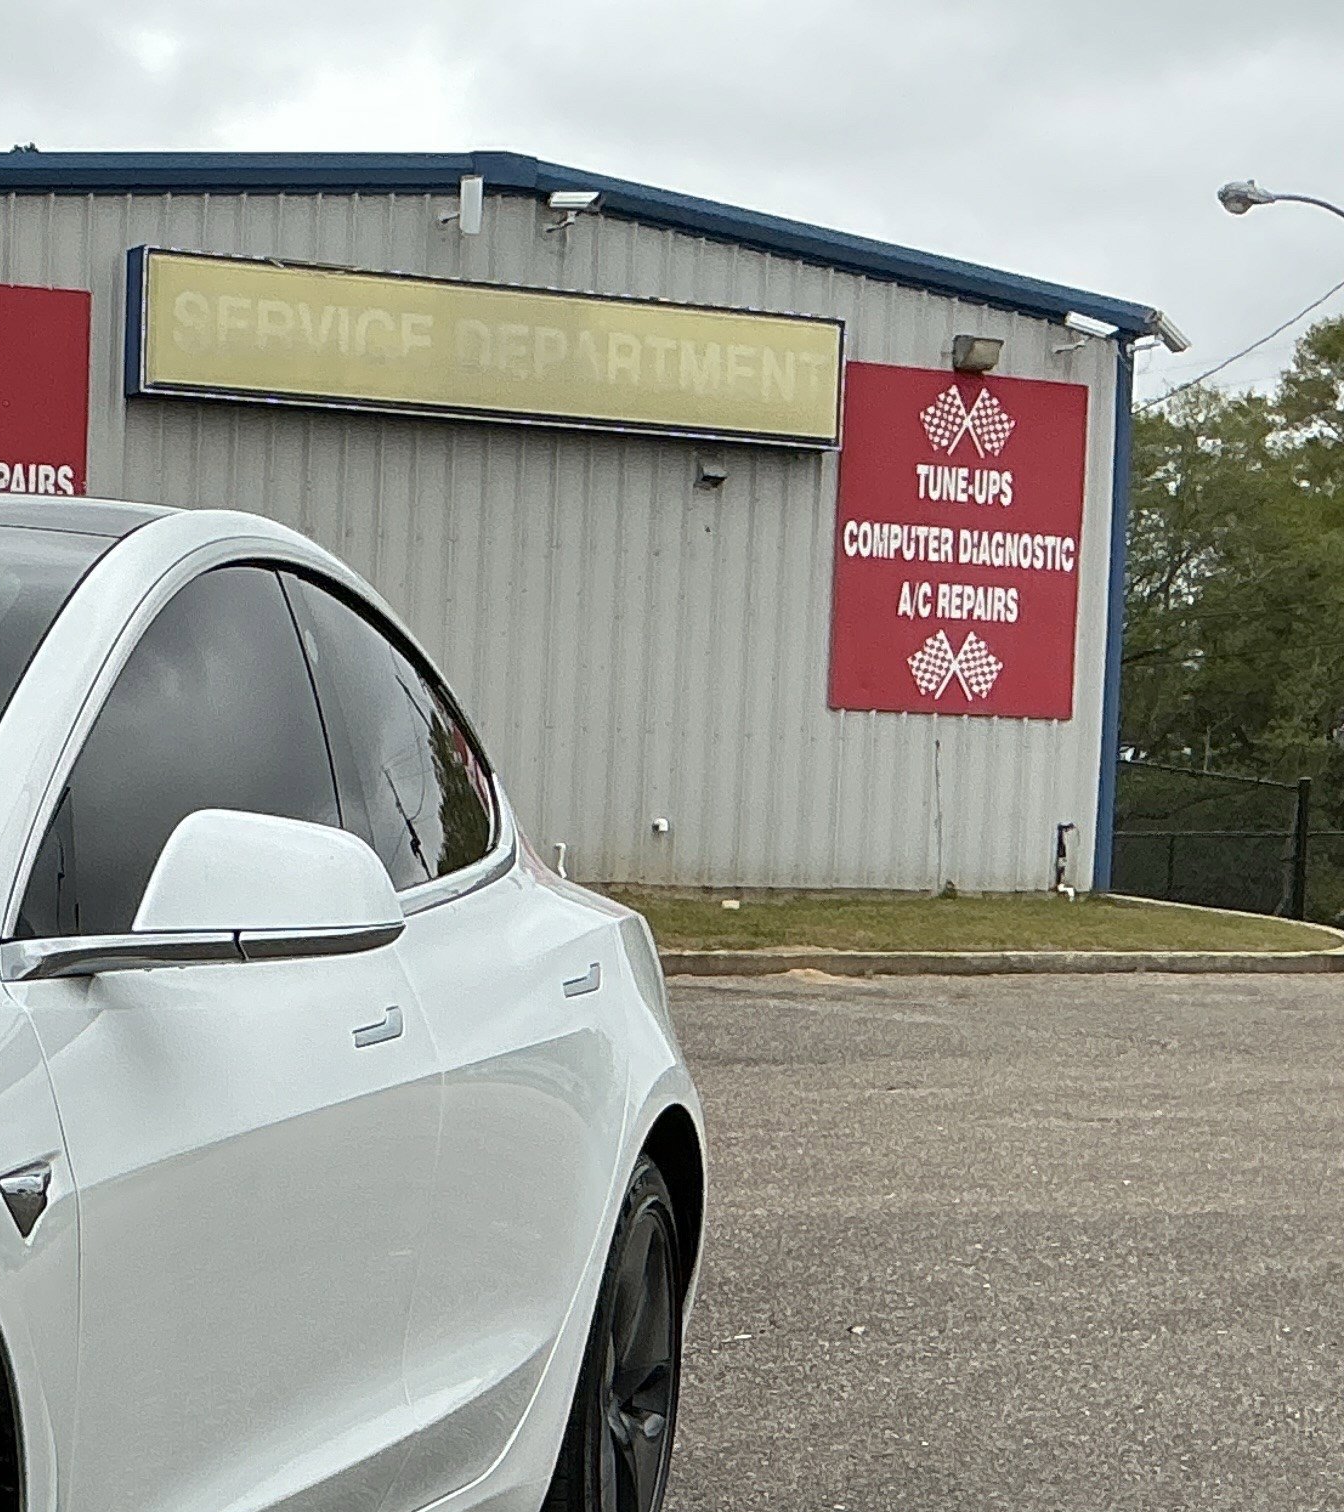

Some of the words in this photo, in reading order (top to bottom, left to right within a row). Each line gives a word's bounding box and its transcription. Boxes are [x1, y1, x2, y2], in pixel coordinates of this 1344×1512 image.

[171, 290, 434, 360] SERVICE
[454, 316, 827, 403] DEPARTMENT
[916, 464, 1013, 505] TUNE-UPS
[843, 520, 954, 563] COMPUTER
[958, 528, 1075, 572] DIAGNOSTIC
[897, 581, 932, 619] A/C
[936, 583, 1019, 623] REPAIRS
